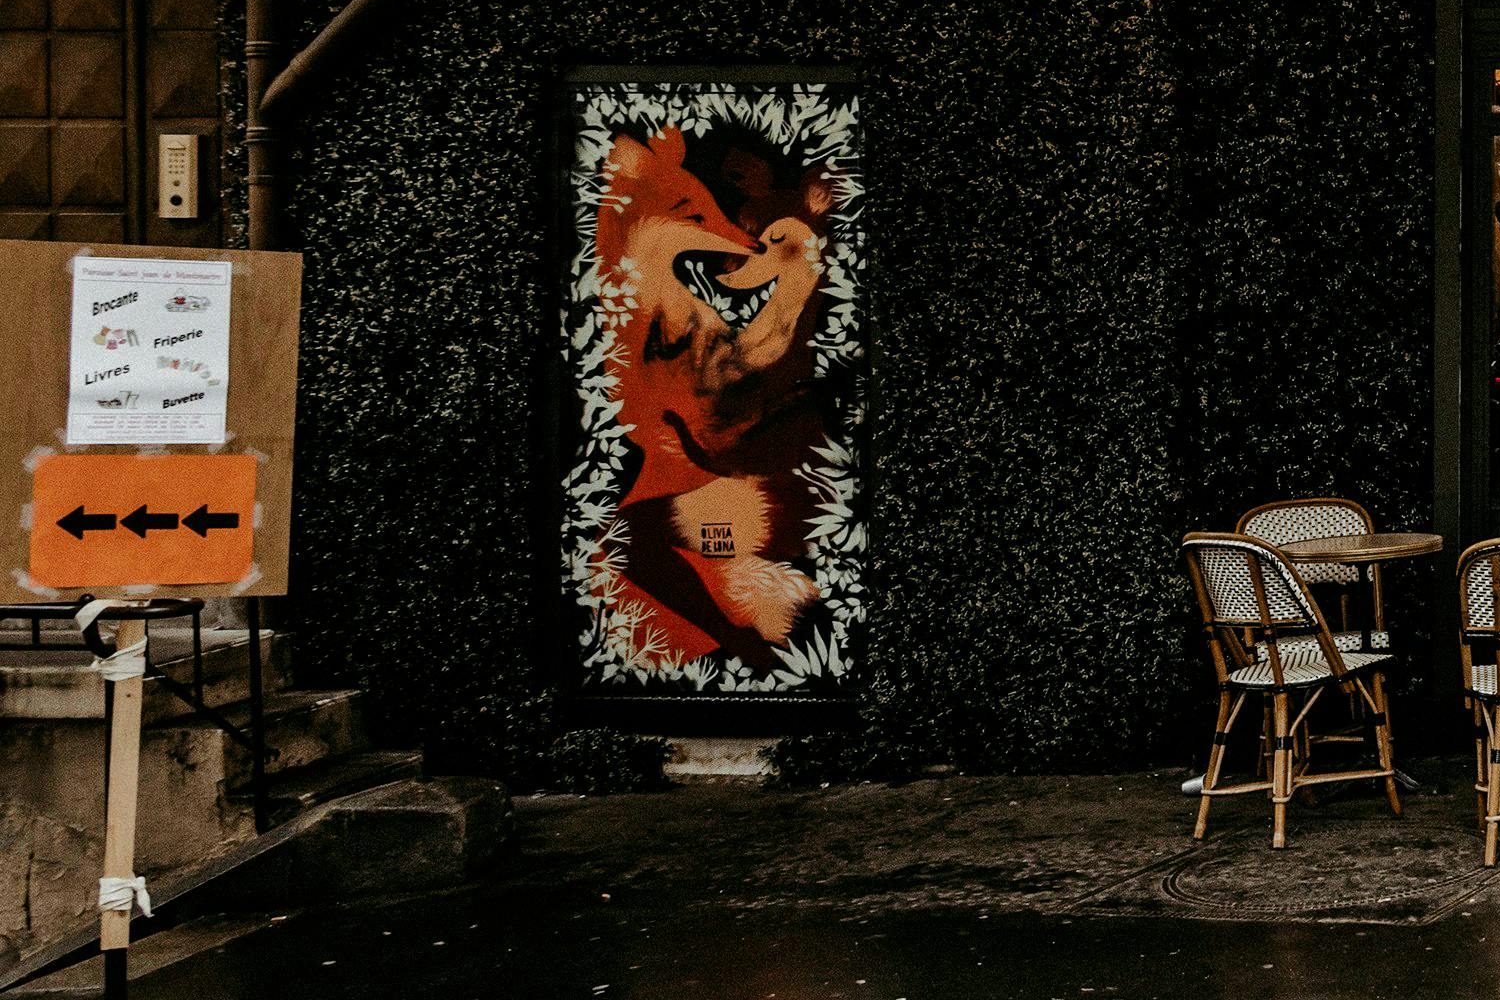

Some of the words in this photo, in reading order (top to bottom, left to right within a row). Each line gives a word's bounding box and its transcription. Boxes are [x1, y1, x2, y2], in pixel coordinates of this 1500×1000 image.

[92, 291, 139, 316] Brocante
[154, 328, 203, 350] Friperie
[84, 364, 130, 386] Livres
[162, 392, 205, 409] Buvette
[701, 527, 732, 539] OLIVIA
